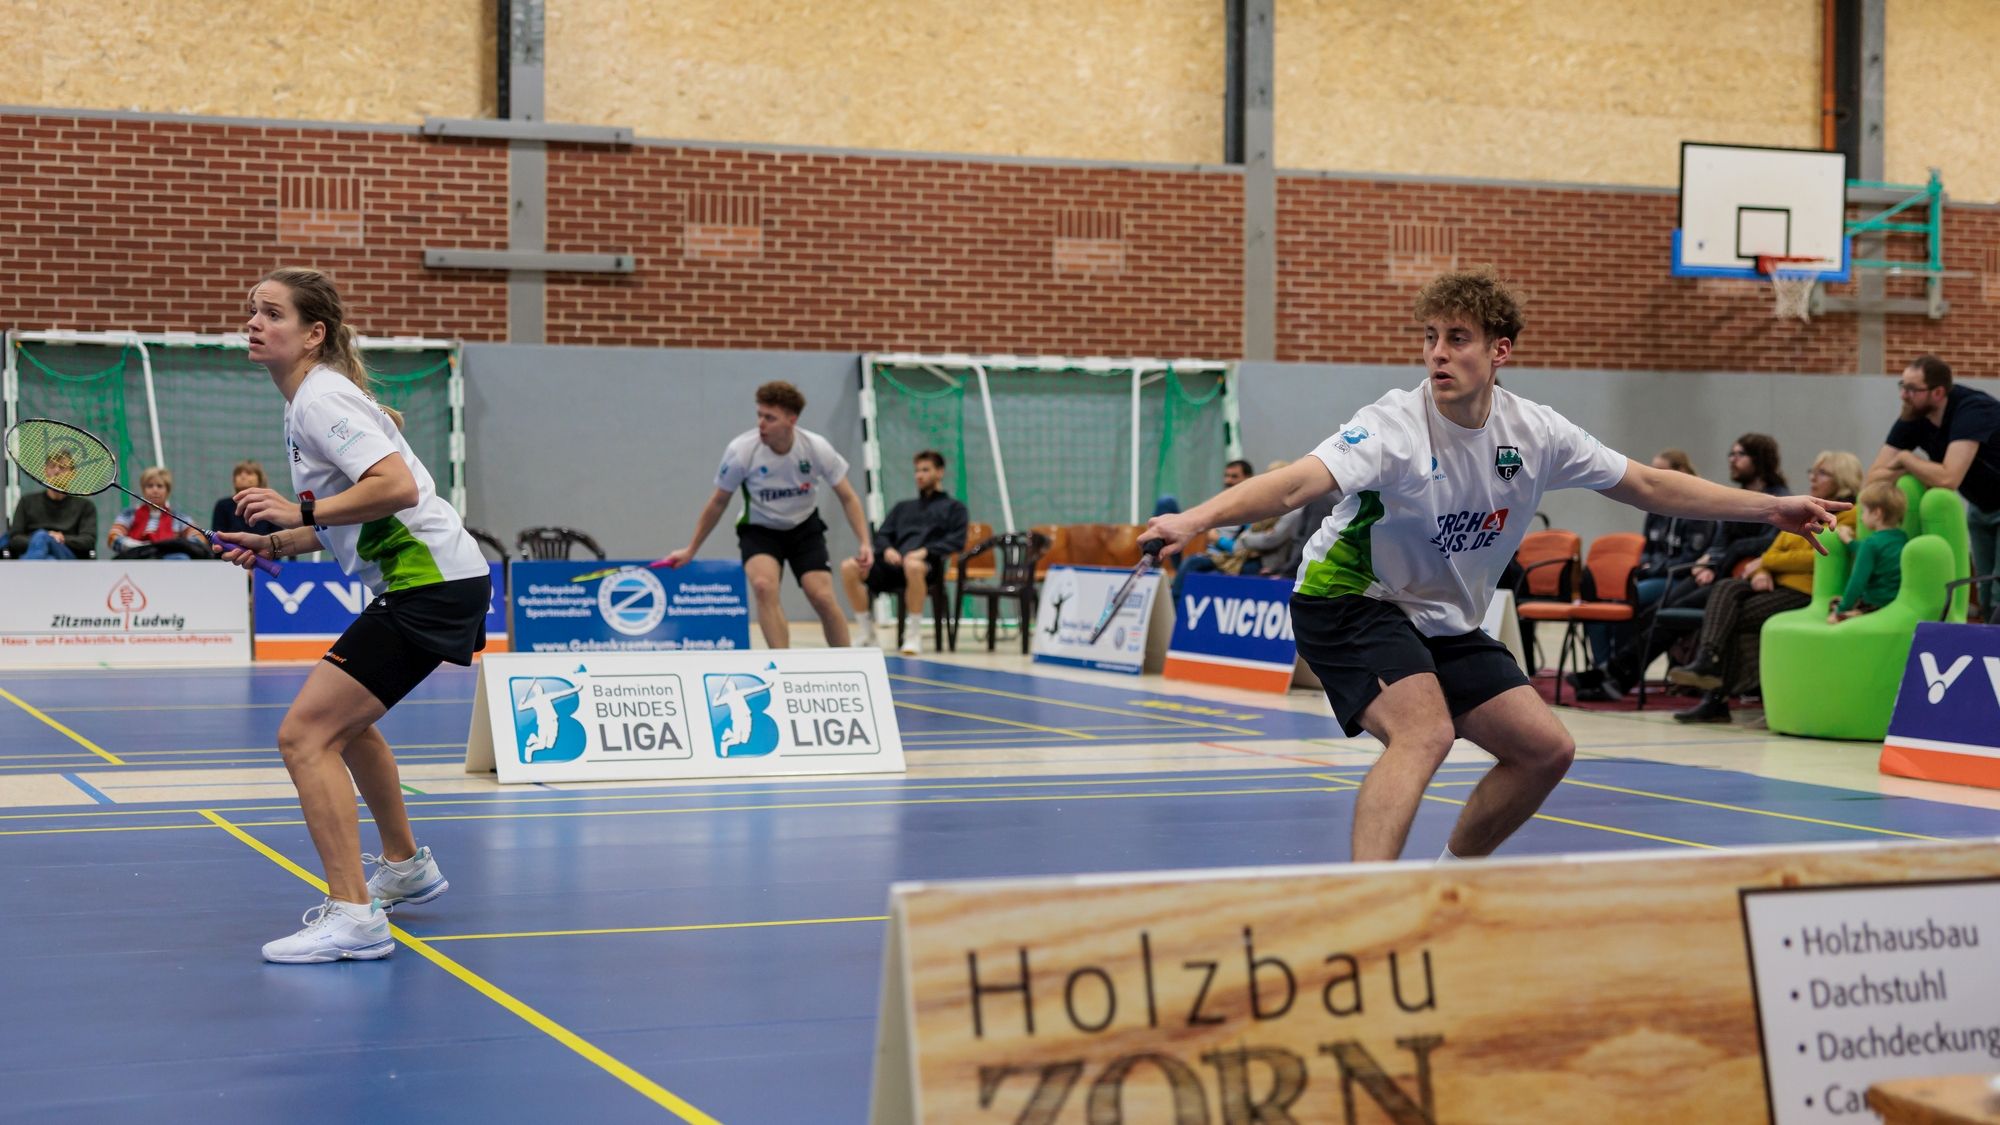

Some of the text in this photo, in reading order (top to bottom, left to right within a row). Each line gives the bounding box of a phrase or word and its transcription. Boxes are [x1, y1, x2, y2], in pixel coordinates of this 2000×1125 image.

[51, 613, 185, 631] Zitzmann Ludwig
[592, 684, 674, 697] Badminton
[783, 681, 860, 694] Badminton
[595, 701, 677, 718] BUNDES
[786, 697, 864, 714] BUNDES
[598, 722, 683, 752] LIGA
[790, 718, 871, 746] LIGA
[1801, 918, 1980, 956] Holzhausbau
[966, 925, 1438, 1038] Holzbau
[1809, 968, 1947, 1009] Dachstuhl
